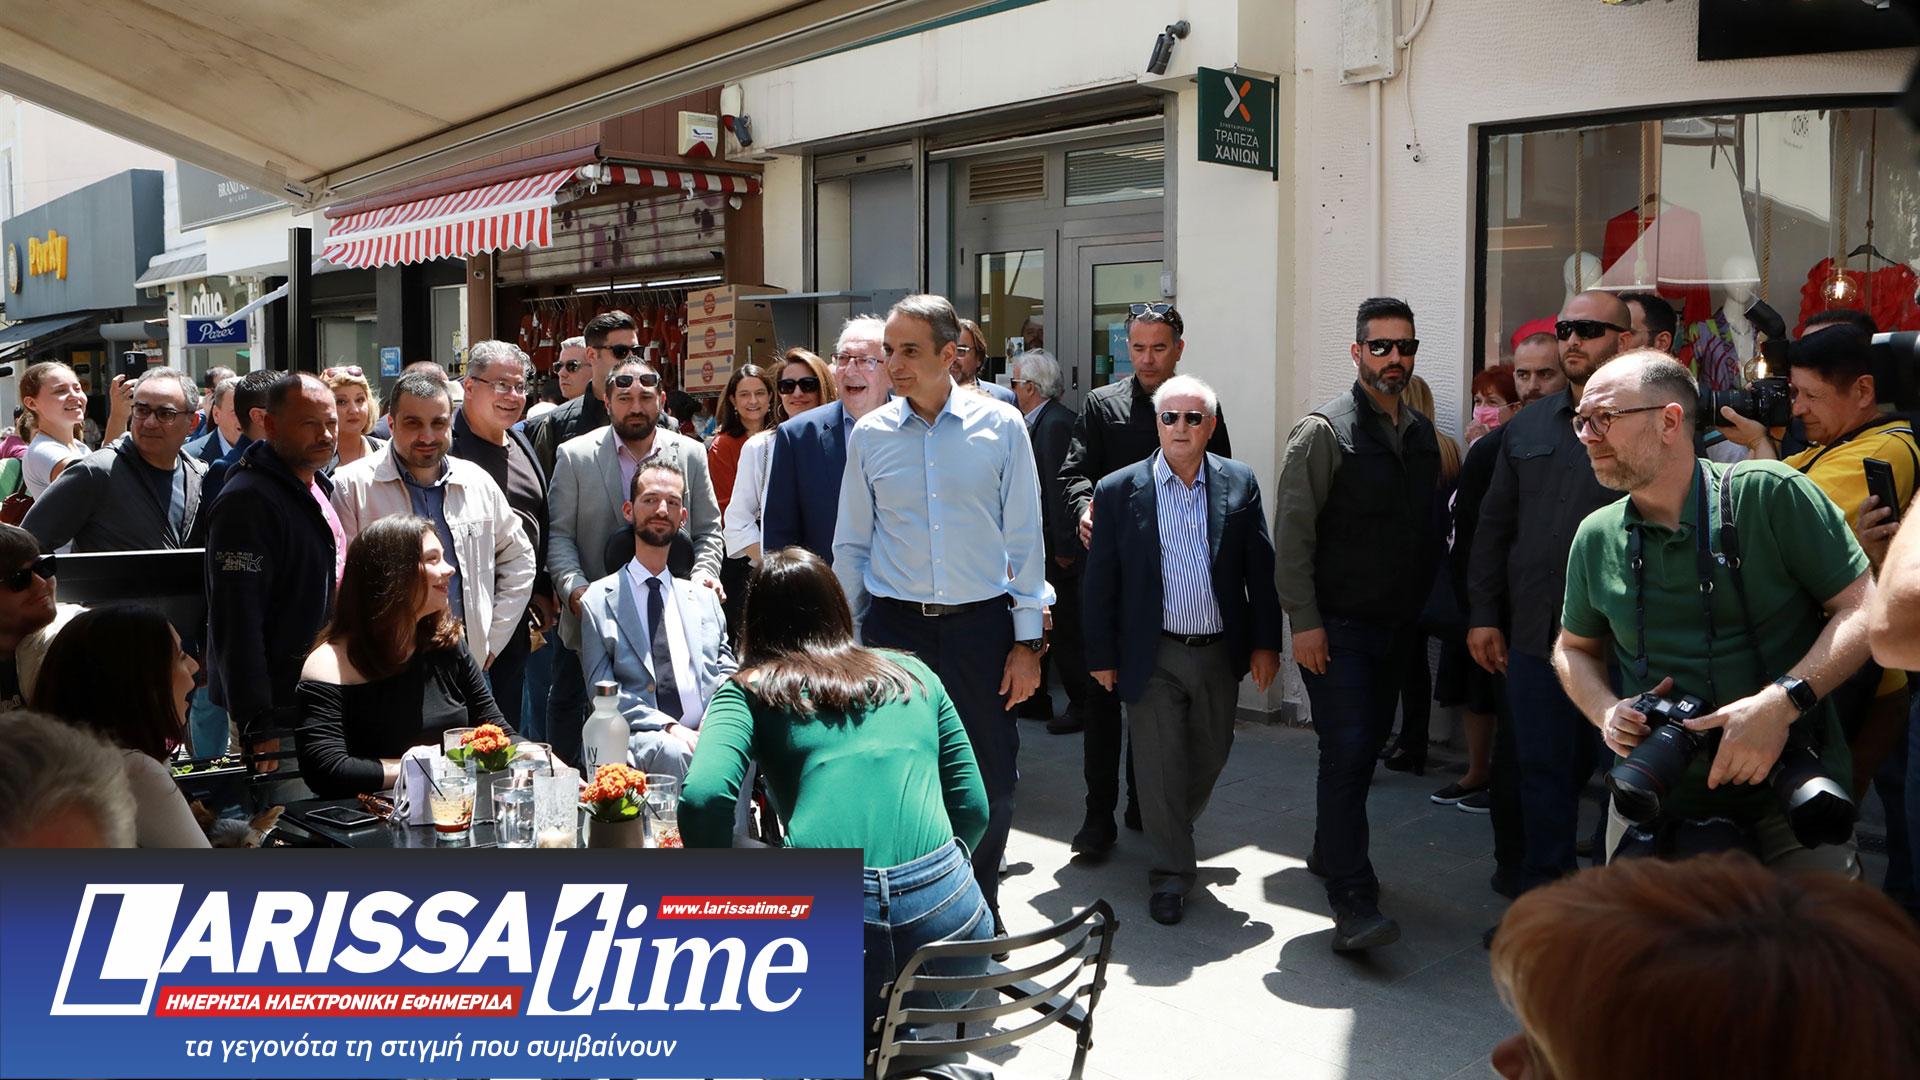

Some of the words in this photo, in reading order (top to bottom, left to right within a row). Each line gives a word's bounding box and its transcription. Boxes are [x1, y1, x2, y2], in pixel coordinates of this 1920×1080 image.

[1215, 128, 1260, 148] ΤΡΑΠΕΖΑ
[1215, 143, 1260, 165] ΧΑΝΙΩΝ
[199, 323, 235, 342] Parex
